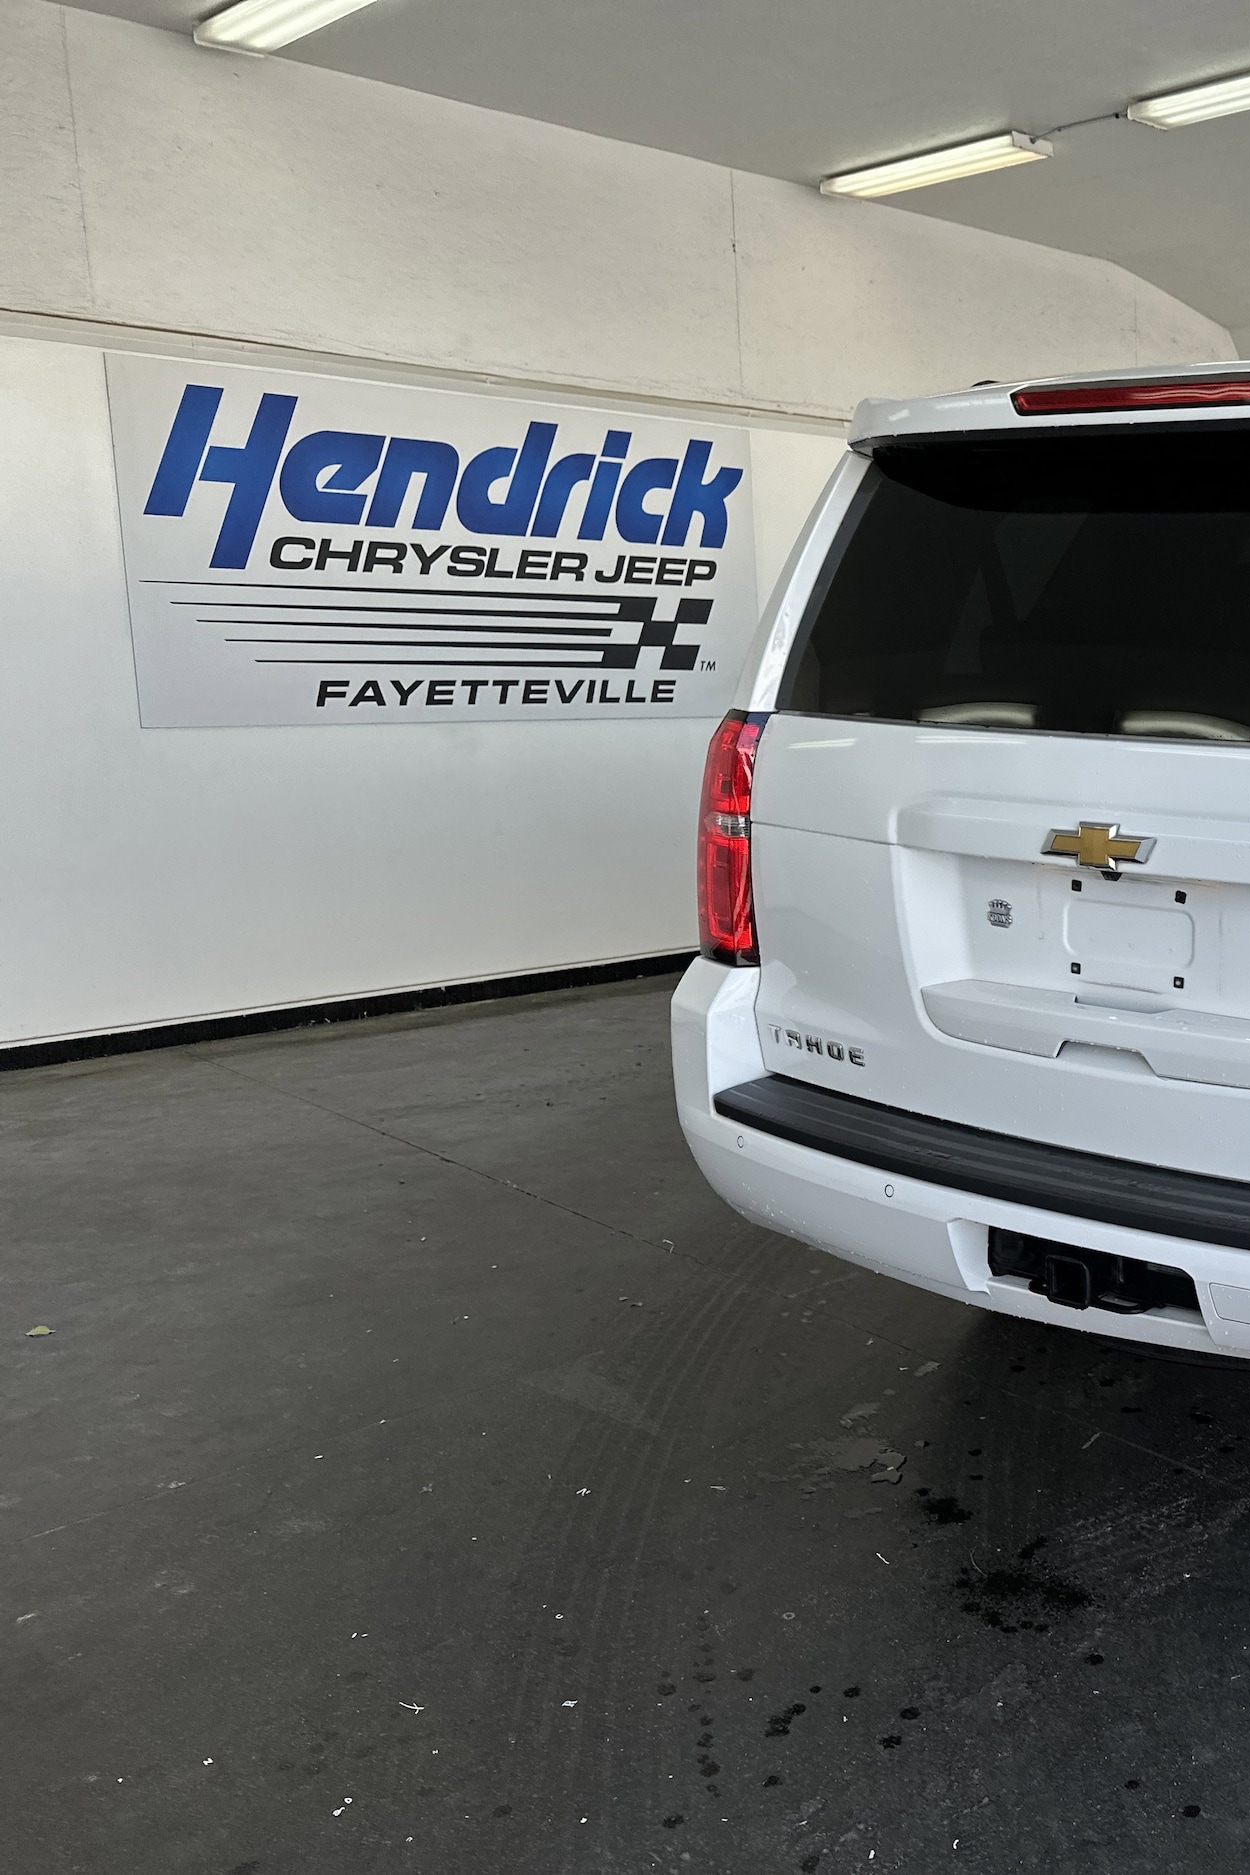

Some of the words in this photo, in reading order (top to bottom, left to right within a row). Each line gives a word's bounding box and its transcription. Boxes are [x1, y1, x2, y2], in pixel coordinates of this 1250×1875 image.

[144, 384, 743, 570] Hendrick
[269, 536, 588, 582] CHRYSLER
[594, 555, 717, 587] JEEP
[700, 660, 716, 671] TM
[316, 679, 677, 708] FAYETTEVILLE
[766, 1023, 866, 1067] TAHOE
